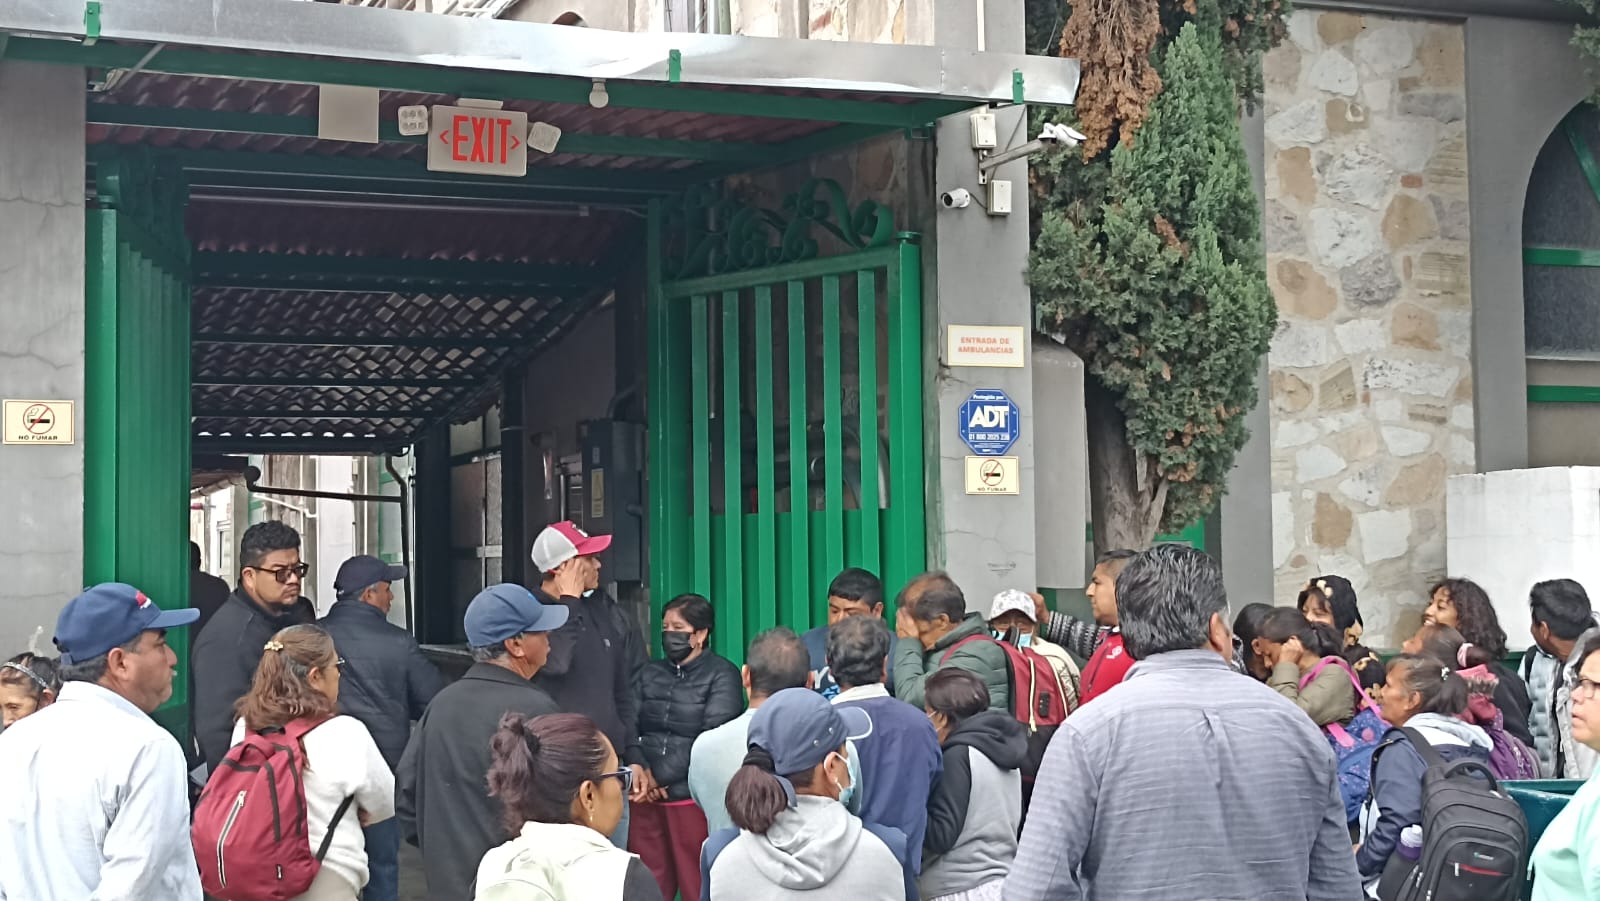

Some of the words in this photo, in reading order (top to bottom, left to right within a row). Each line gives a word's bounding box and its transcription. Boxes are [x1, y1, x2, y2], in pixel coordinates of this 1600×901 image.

[453, 114, 512, 165] EXIT
[960, 336, 997, 345] ENTRADA
[999, 337, 1010, 345] DE
[958, 345, 1015, 354] AMBULANCIAS
[969, 405, 1009, 428] ADT
